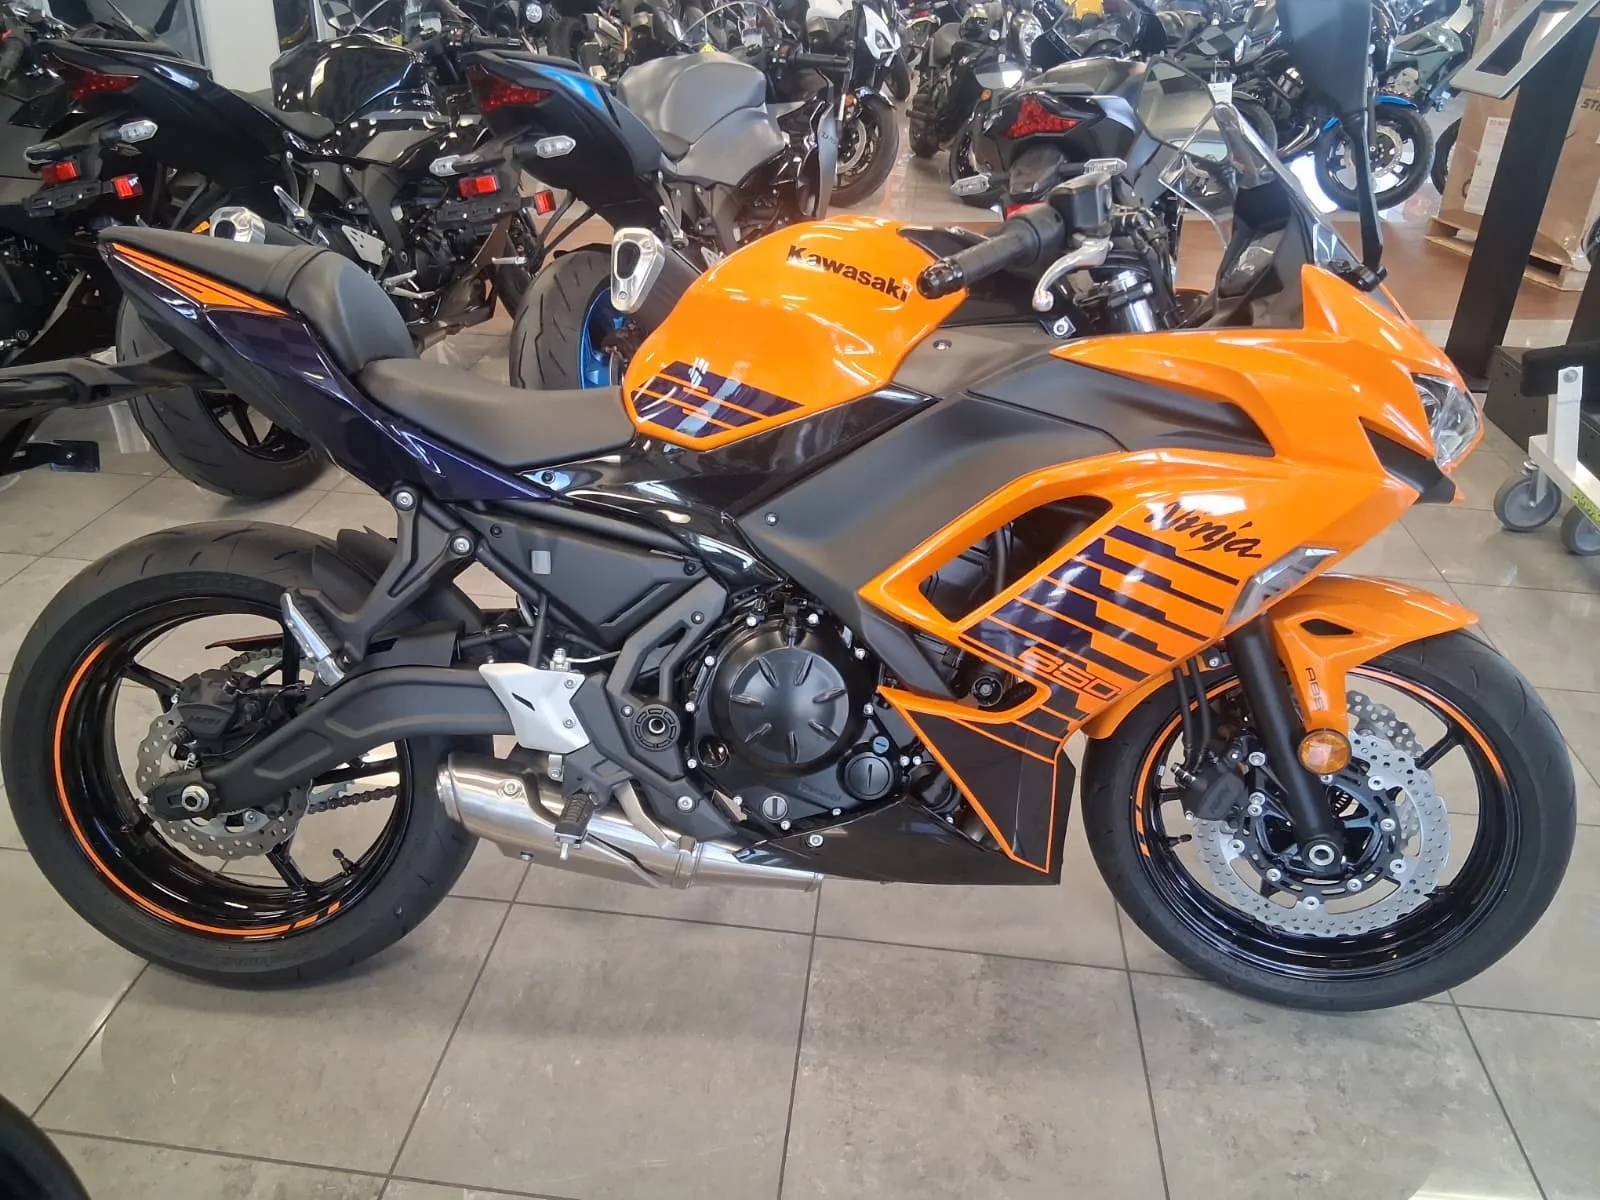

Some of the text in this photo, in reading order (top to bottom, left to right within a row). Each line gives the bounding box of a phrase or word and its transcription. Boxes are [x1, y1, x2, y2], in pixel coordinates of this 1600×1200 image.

[786, 244, 910, 302] Kawasaki
[1144, 500, 1262, 558] Ninja
[1018, 646, 1121, 701] 650
